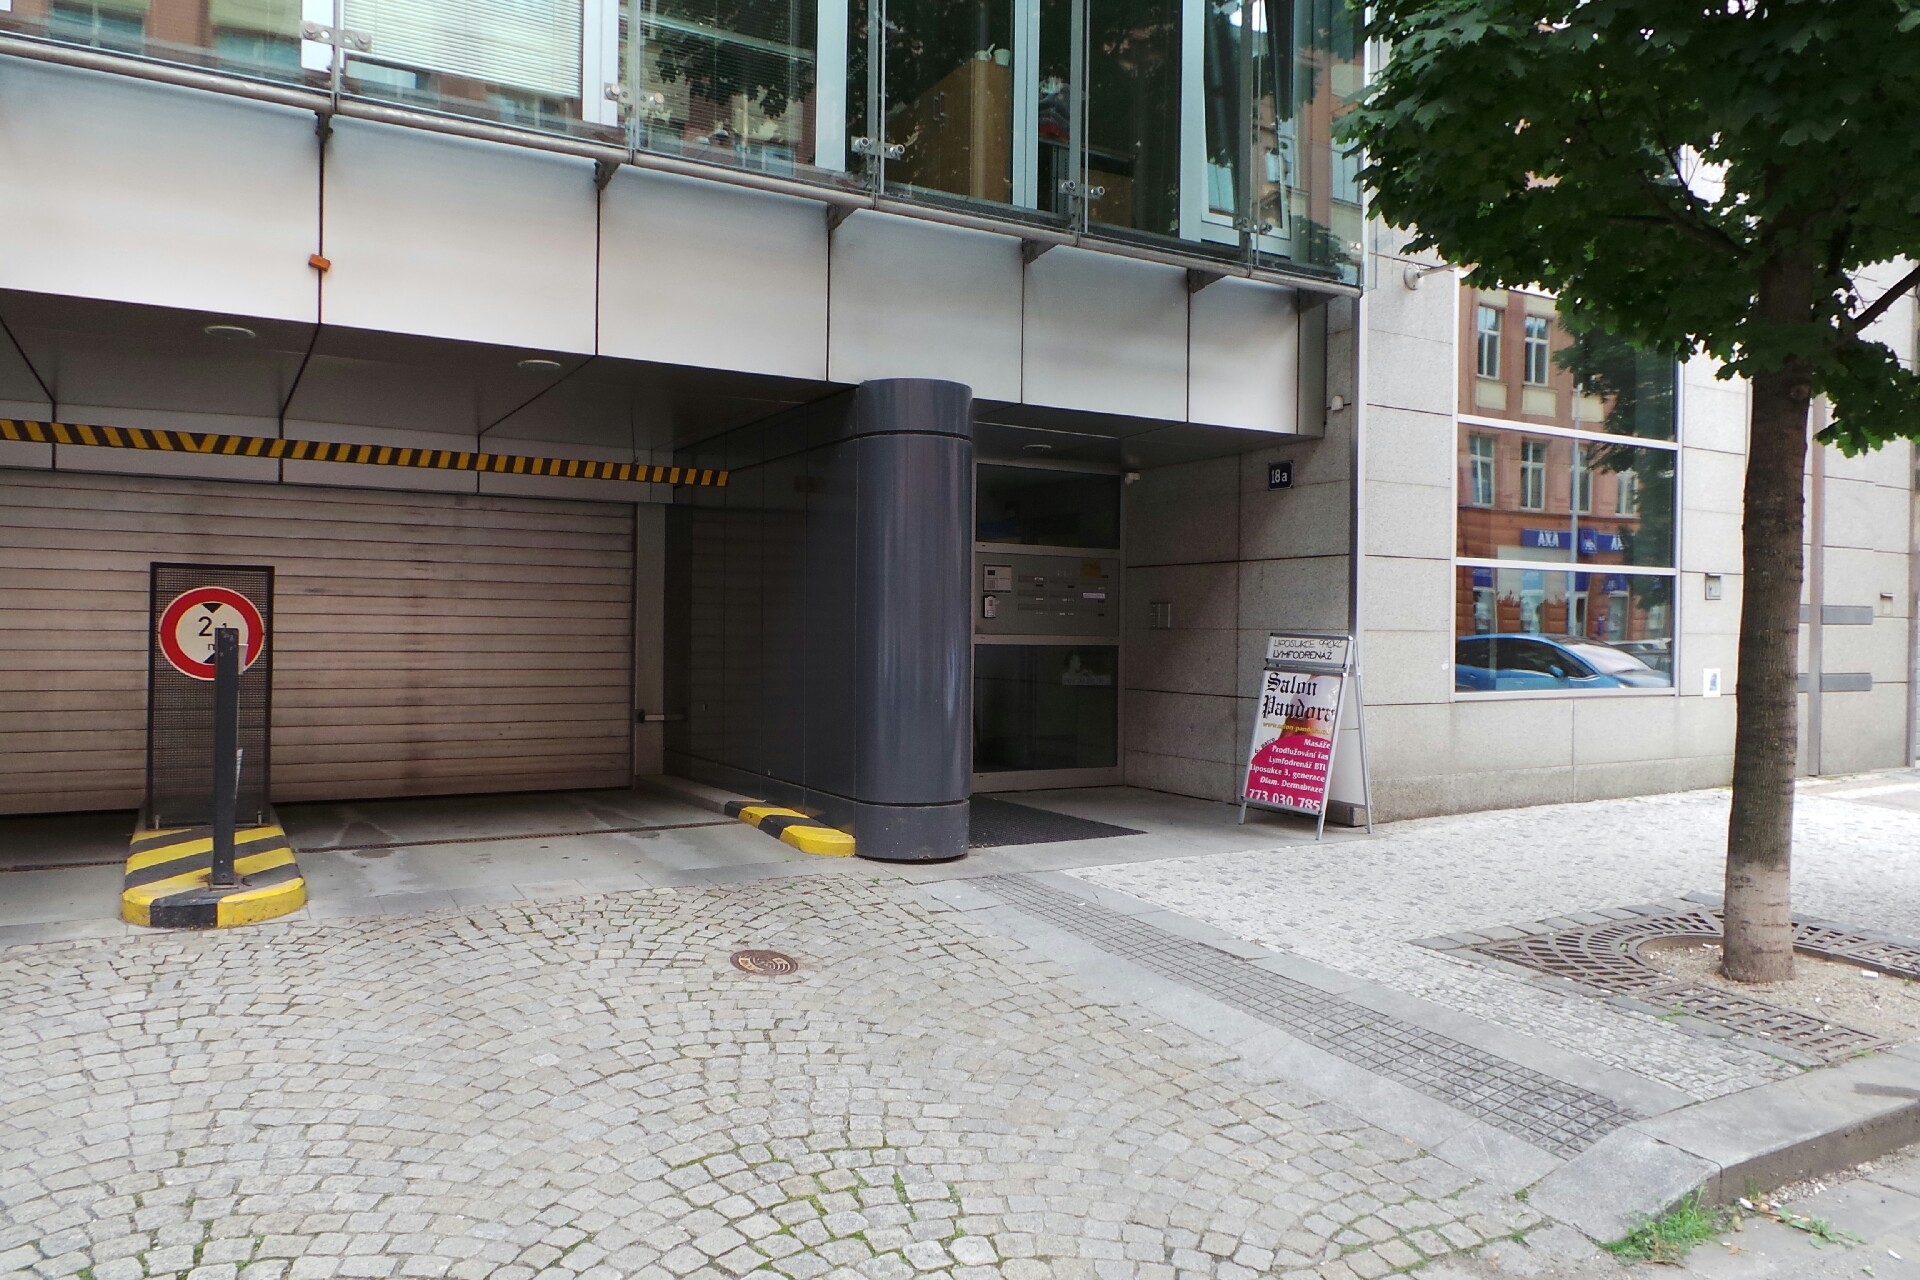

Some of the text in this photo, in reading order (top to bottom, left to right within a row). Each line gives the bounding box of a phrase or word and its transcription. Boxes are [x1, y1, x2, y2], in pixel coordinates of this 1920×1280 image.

[1266, 672, 1318, 696] Salon
[1304, 739, 1331, 749] Masáže
[1271, 745, 1316, 759] Prodlužování
[1269, 756, 1312, 769] Lymfodrenáž
[1250, 764, 1282, 776] Liposukce
[1293, 772, 1325, 783] generace
[1281, 780, 1324, 793] Dermabraze
[1249, 789, 1321, 811] 773 030 785
